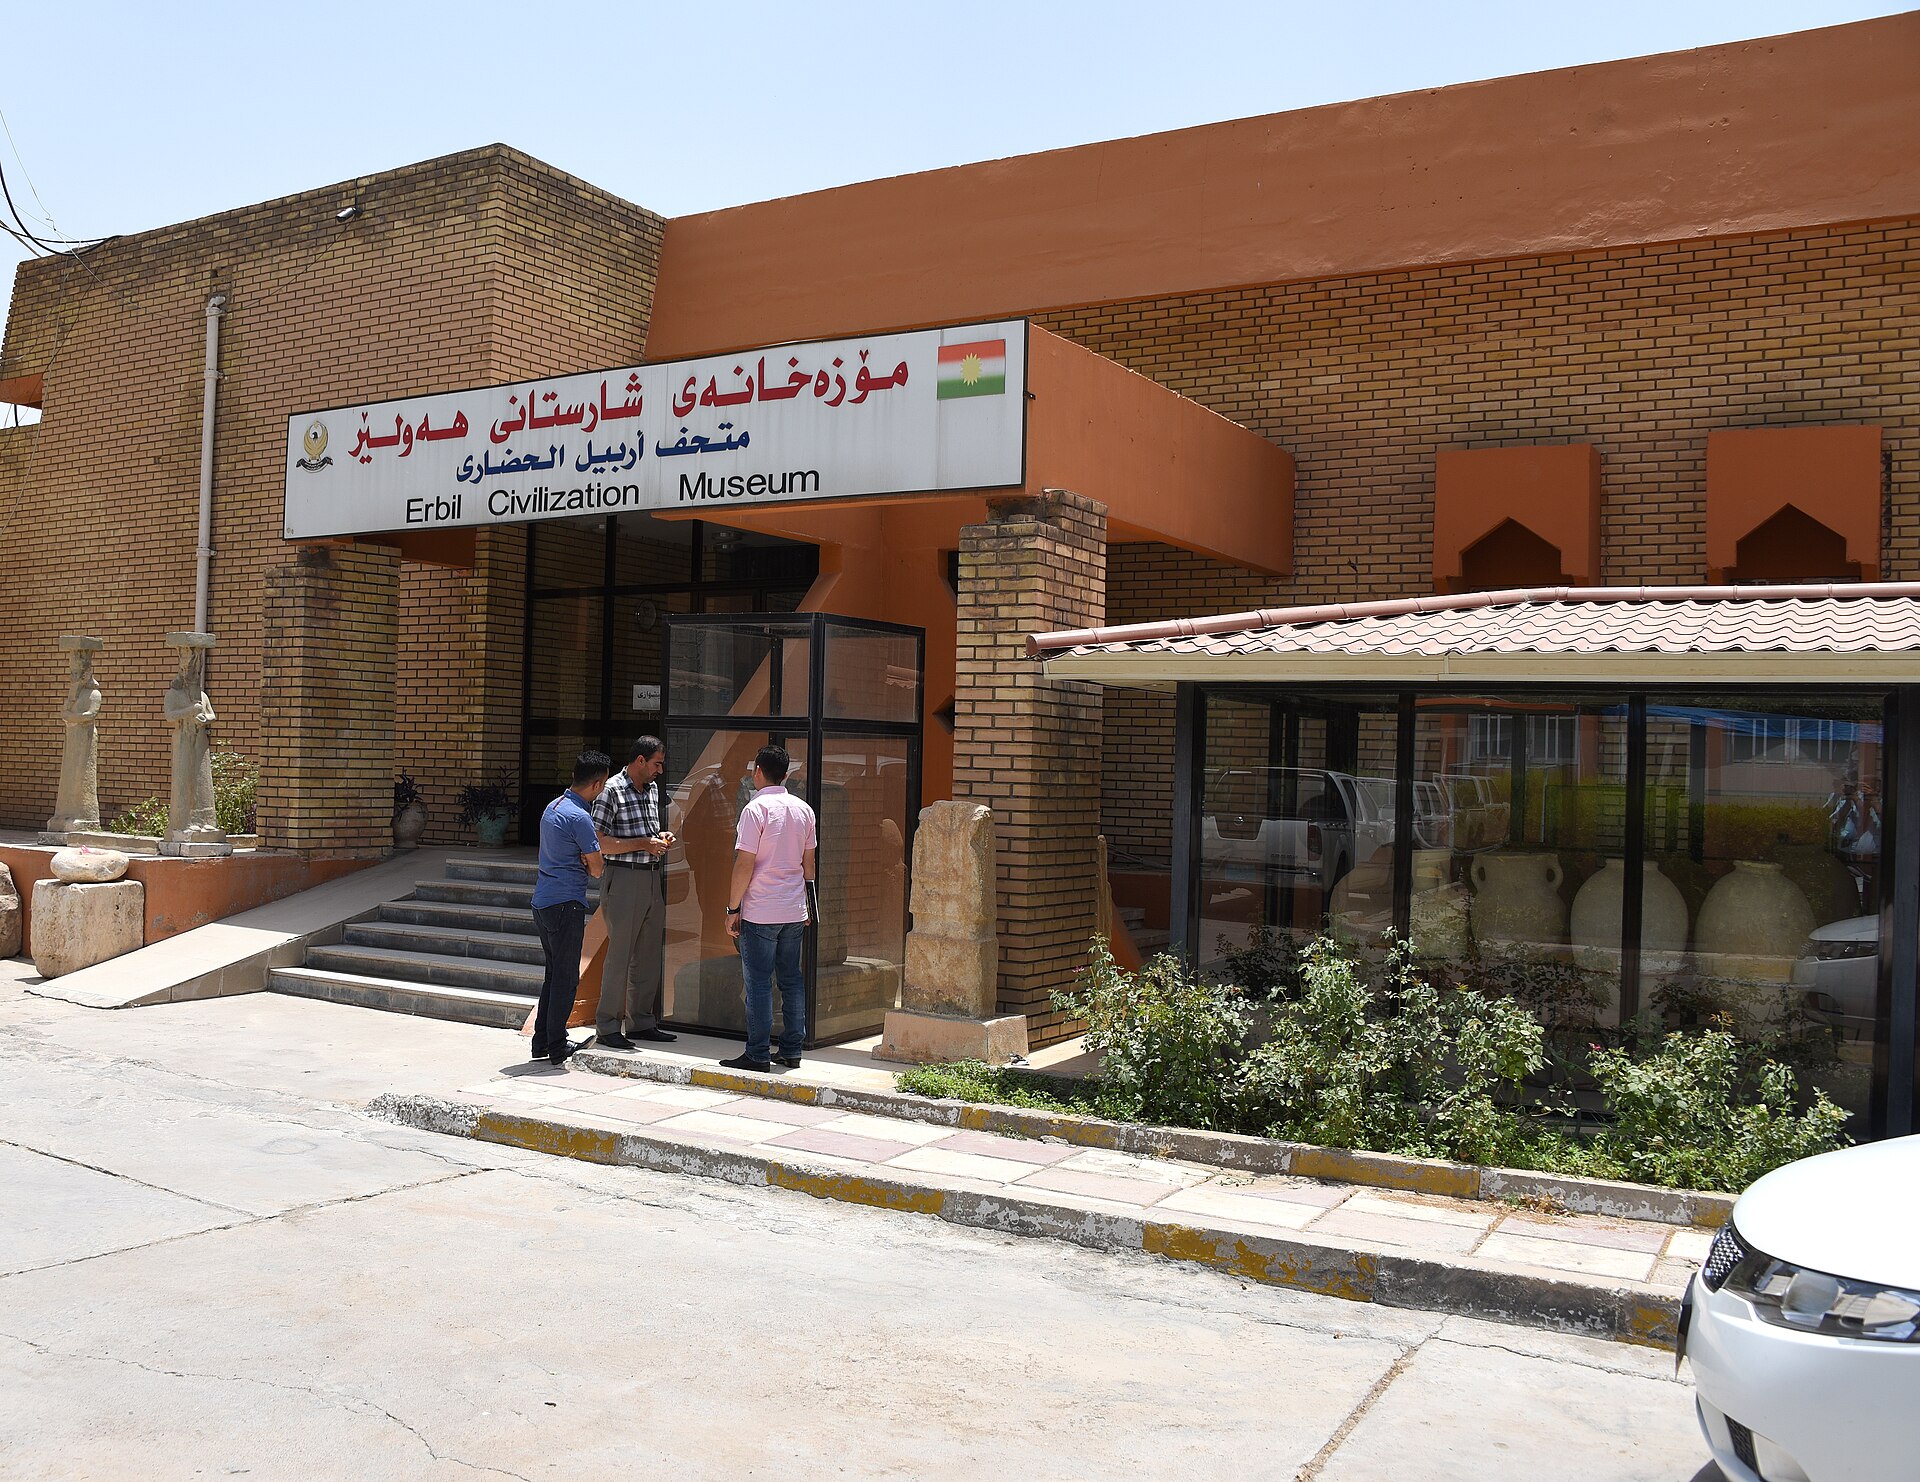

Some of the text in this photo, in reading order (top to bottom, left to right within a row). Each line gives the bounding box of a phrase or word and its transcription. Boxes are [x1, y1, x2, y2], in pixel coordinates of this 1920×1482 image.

[575, 430, 645, 474] أربيل
[655, 422, 750, 457] متحف
[406, 469, 820, 523] Erbil Civilization Museum
